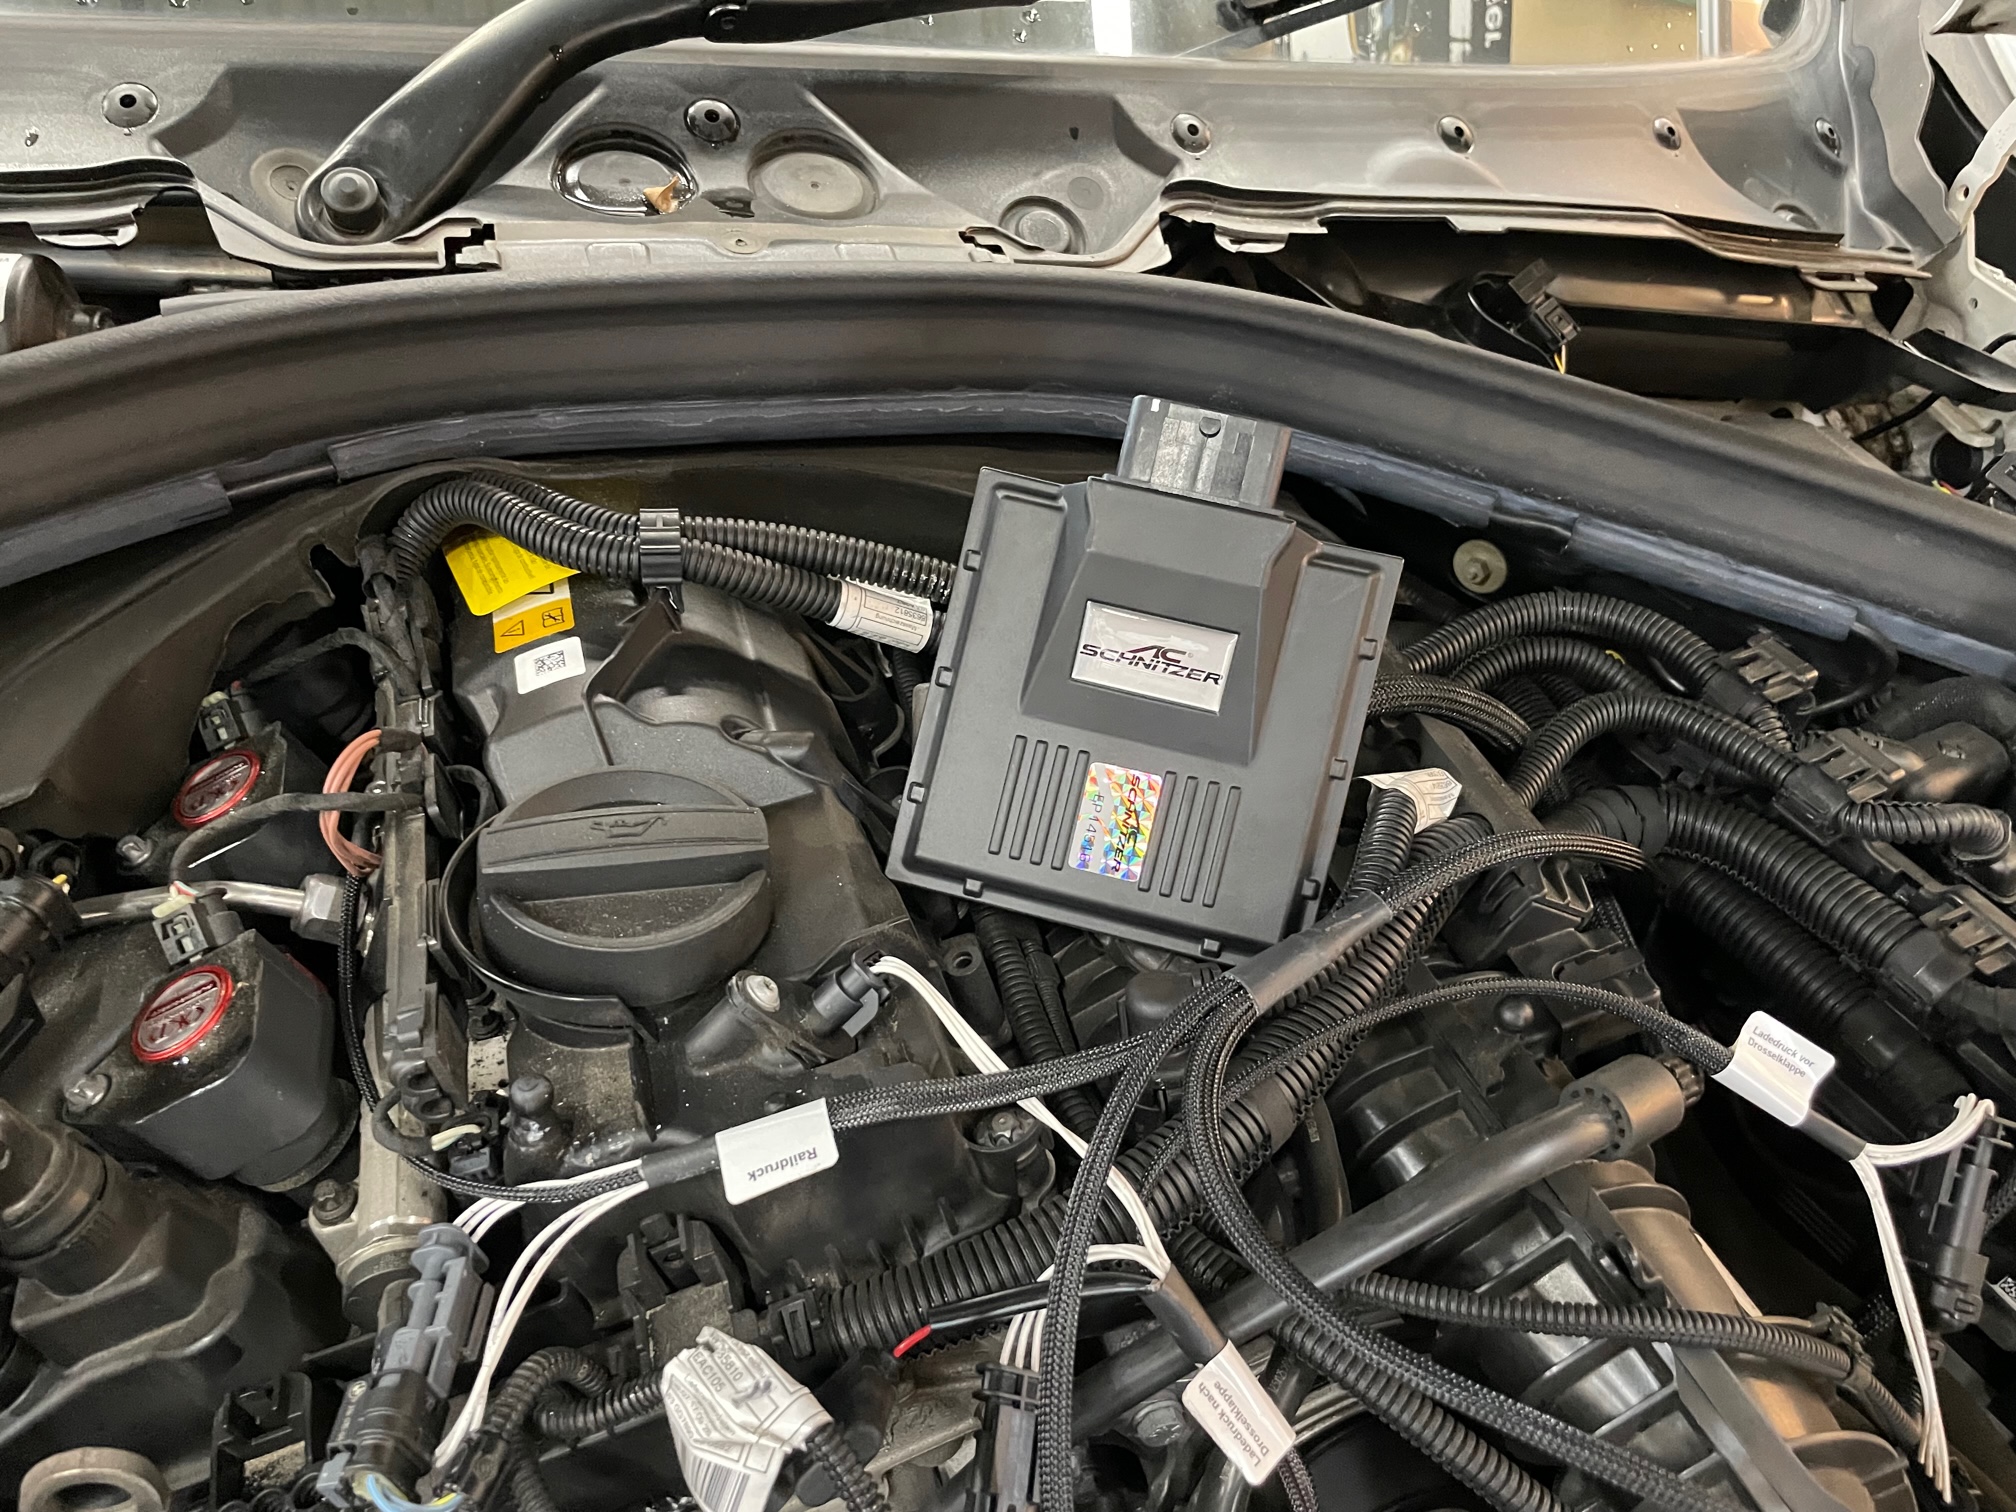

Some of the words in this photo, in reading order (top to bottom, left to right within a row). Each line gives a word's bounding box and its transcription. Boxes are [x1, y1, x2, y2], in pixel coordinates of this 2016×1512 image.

[1080, 643, 1223, 686] SCHNITZER
[1127, 643, 1187, 664] AC
[1111, 773, 1141, 873] SCHNITZER
[1747, 1036, 1807, 1078] Drosselklappe
[1752, 1025, 1799, 1059] Ladedruck
[1799, 1054, 1816, 1069] vor
[747, 1147, 818, 1182] Raildruck
[692, 1351, 726, 1393] EAC105
[1198, 1381, 1221, 1411] nach
[1213, 1380, 1270, 1458] Drosselklappe
[1217, 1408, 1262, 1468] Ladedruck
